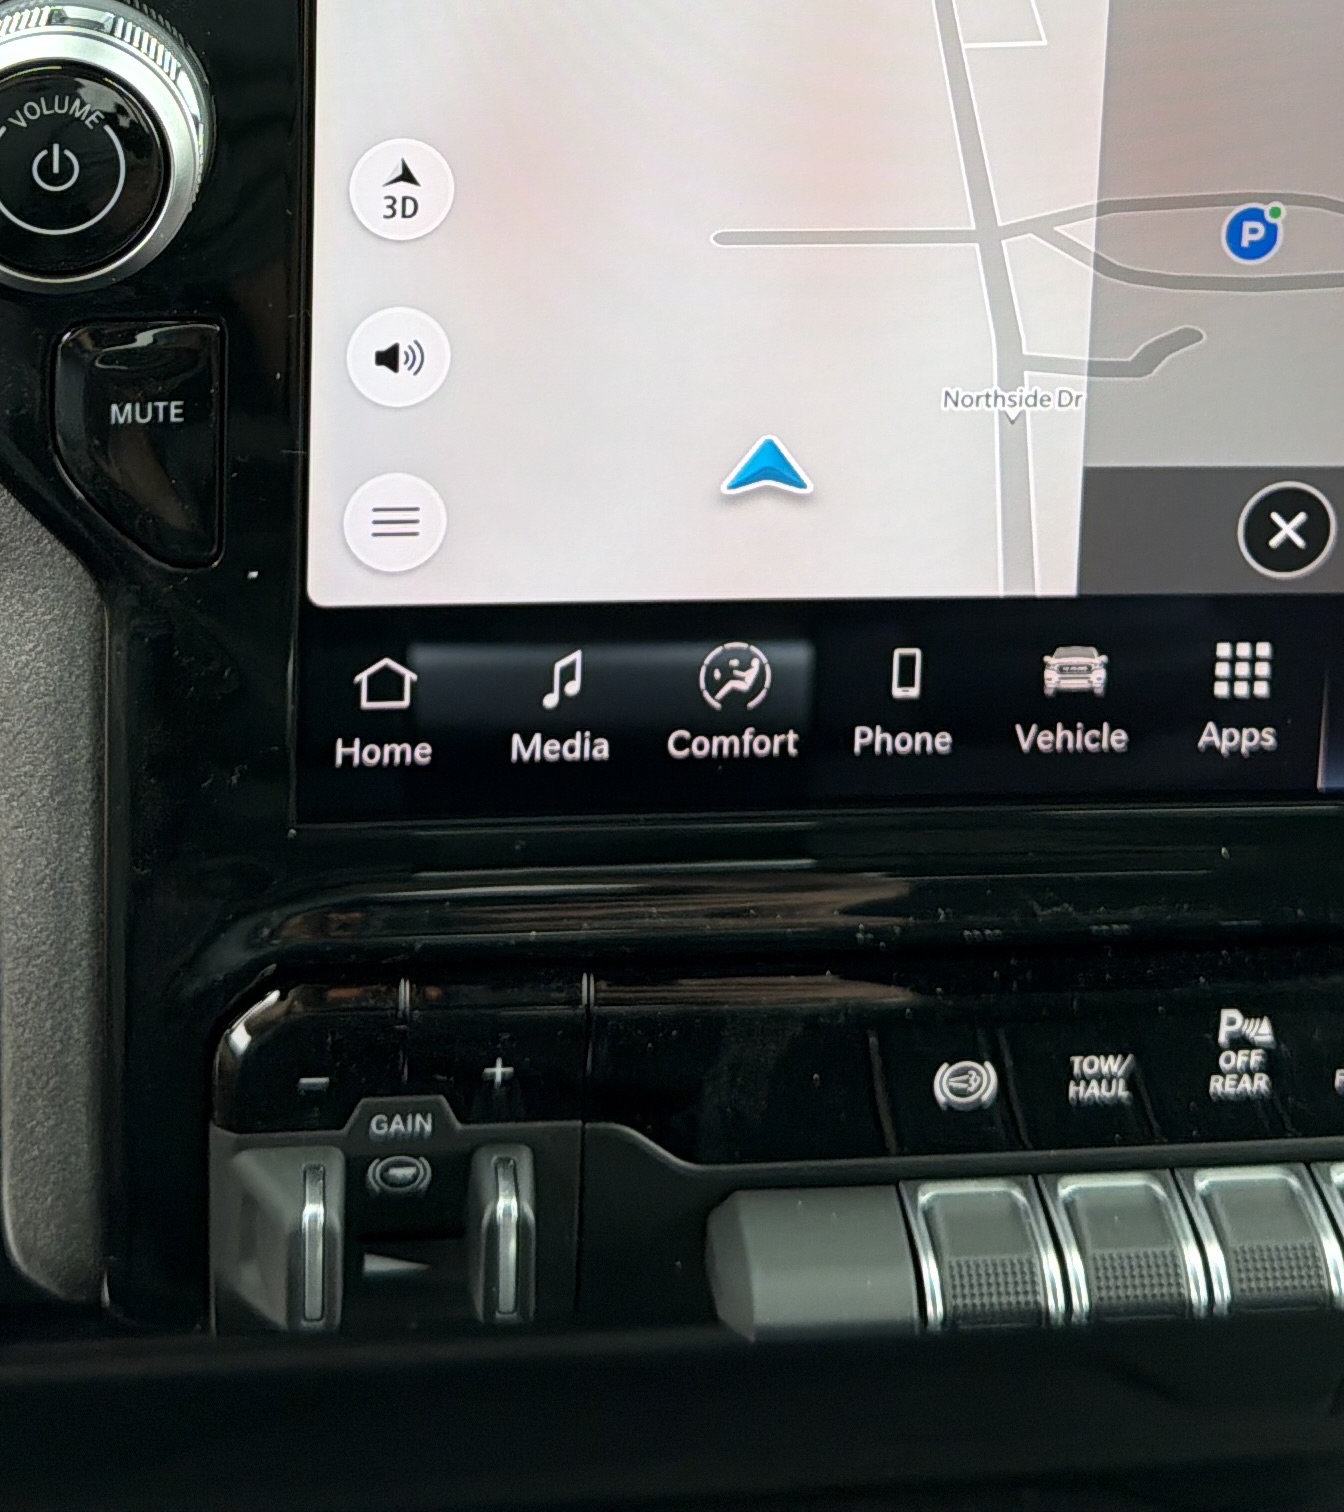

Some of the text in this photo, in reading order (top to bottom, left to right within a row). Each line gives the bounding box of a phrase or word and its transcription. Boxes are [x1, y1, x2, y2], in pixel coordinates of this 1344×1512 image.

[8, 94, 107, 131] VOLUME
[382, 195, 419, 220] 3D
[1240, 220, 1266, 248] P
[109, 400, 185, 425] MUTE
[942, 389, 1083, 410] Northside Dr
[511, 731, 610, 762] Media
[667, 727, 799, 759] Comfort
[853, 724, 953, 756] Phone
[1015, 722, 1129, 755] Vehicle
[1197, 719, 1278, 758] Apps
[335, 738, 433, 768] Home
[1069, 1054, 1135, 1078] TOW/
[1218, 1048, 1265, 1071] OFF
[1067, 1077, 1134, 1104] HAUL
[1208, 1073, 1270, 1102] REAR
[369, 1112, 433, 1140] GAIN
